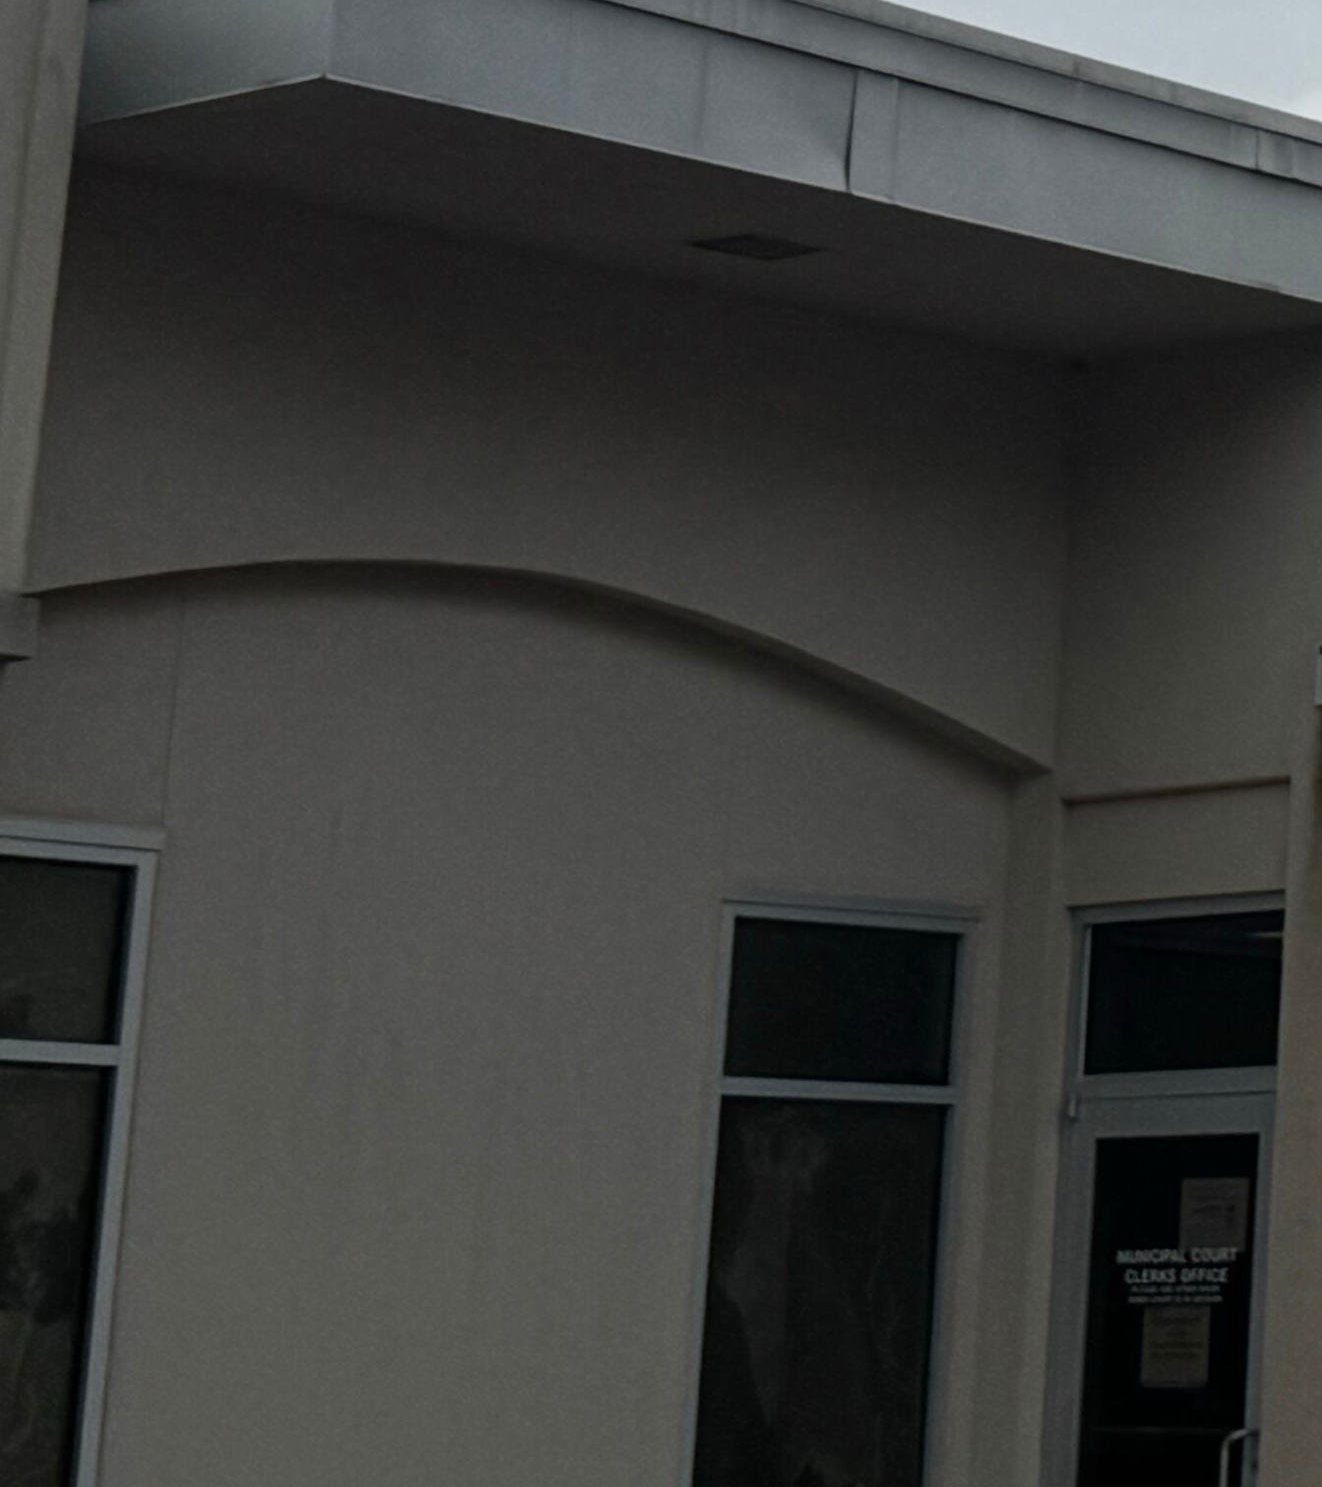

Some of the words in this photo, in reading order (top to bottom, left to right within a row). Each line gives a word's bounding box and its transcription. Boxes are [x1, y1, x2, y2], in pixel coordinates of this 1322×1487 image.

[1116, 1248, 1187, 1264] MUNICIPAL
[1191, 1246, 1238, 1263] COURT
[1124, 1268, 1176, 1284] CLERKS
[1179, 1267, 1229, 1283] OFFICE
